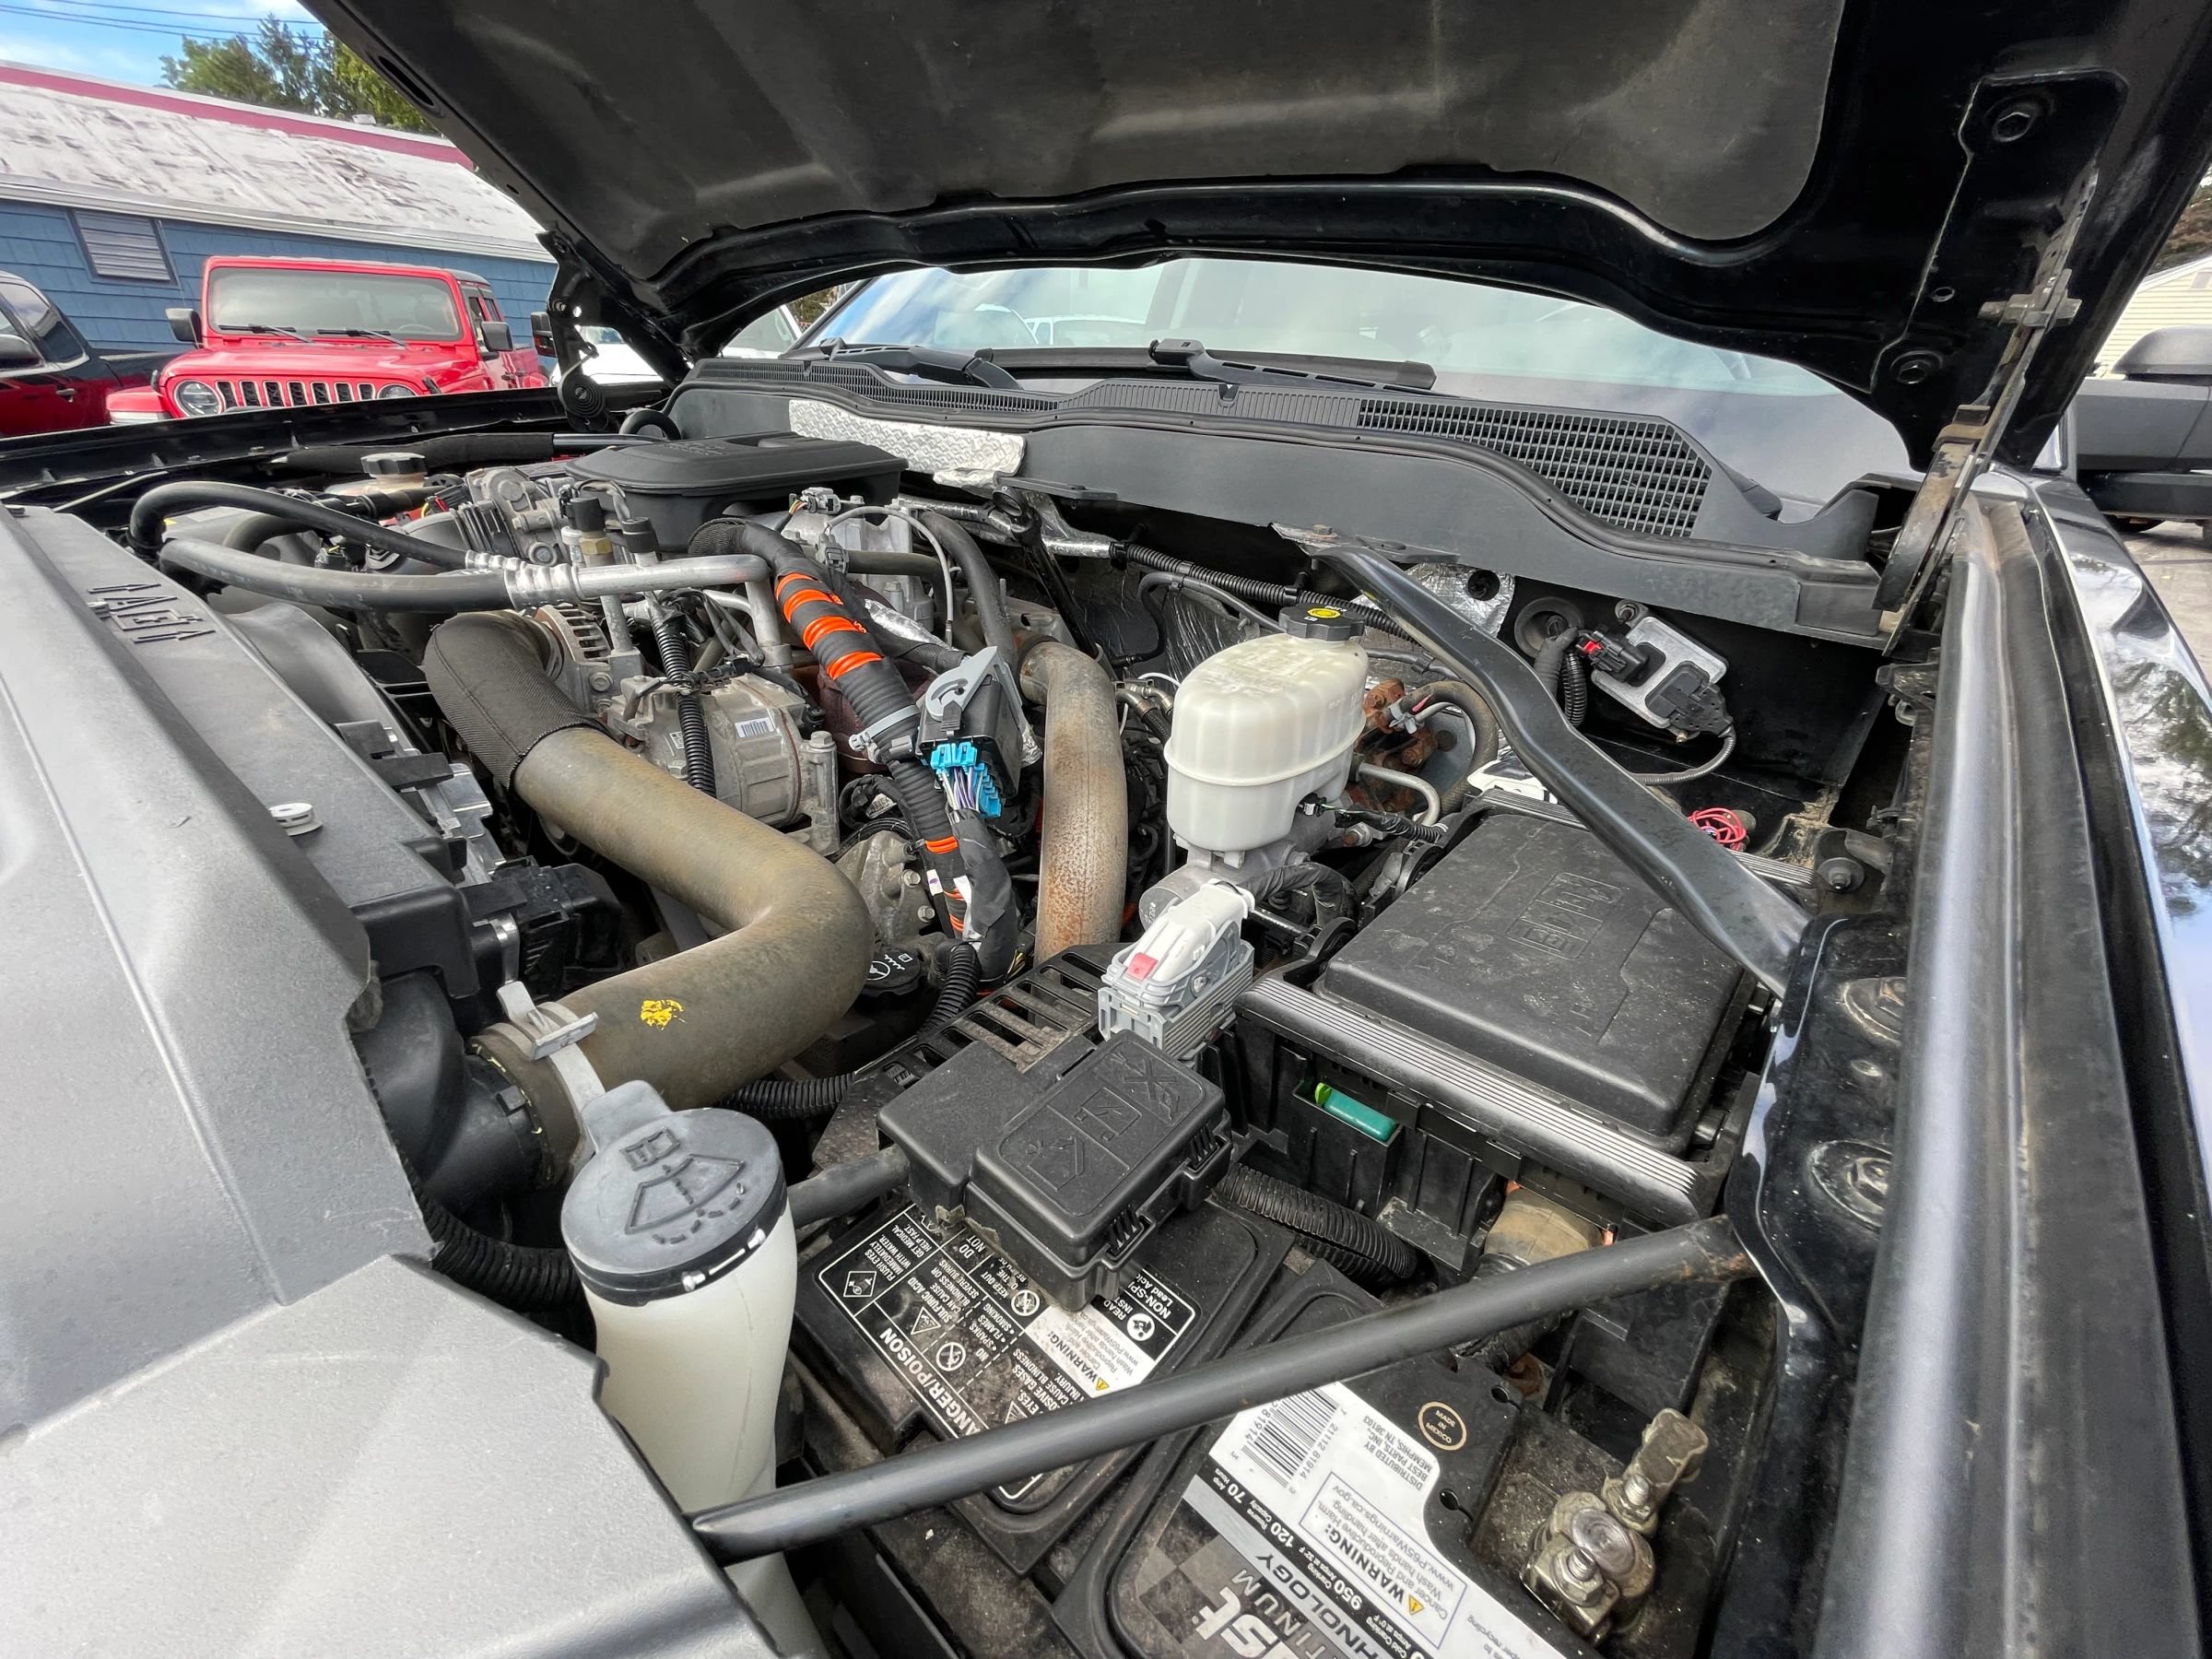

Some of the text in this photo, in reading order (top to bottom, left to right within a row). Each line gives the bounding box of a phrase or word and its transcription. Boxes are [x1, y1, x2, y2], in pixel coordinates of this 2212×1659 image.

[876, 1233, 912, 1269] WITH WATER.
[888, 1223, 925, 1258] GET MEDICAL
[901, 1223, 933, 1252] HELP FAST.
[957, 1242, 975, 1259] DO
[964, 1232, 987, 1253] NOT
[863, 1248, 896, 1281] FLUSH EYES
[868, 1239, 904, 1275] IMMEDIATELY
[929, 1265, 971, 1307] BLINDNESS OR
[954, 1275, 981, 1300] SEVERE
[979, 1269, 1010, 1299] KEEP OUT
[994, 1267, 1012, 1283] THE
[906, 1276, 953, 1324] SULFURIC ACID
[928, 1281, 962, 1314] CAN CAUSE
[1101, 1298, 1127, 1320] READ
[1112, 1295, 1134, 1313] INST
[1125, 1280, 1172, 1319] NON-SPI
[1148, 1286, 1174, 1307] Lead
[976, 1313, 1004, 1340] FLAMES
[982, 1301, 1012, 1331] SMOKING
[968, 1322, 994, 1348] SPARKS
[1076, 1309, 1141, 1367] www.P65Warnings.ca
[973, 1347, 990, 1361] NO
[1044, 1330, 1100, 1382] WARNING:
[1112, 1356, 1135, 1376] Wash
[878, 1326, 982, 1441] ANGER/POISON
[1010, 1363, 1061, 1414] OSIVE GASES
[1011, 1347, 1070, 1405] CAUSE BLINDNESS
[1052, 1371, 1082, 1400] INJURY.
[1013, 1388, 1040, 1415] EYES.
[1424, 1420, 1453, 1445] MEXICO
[1434, 1408, 1457, 1429] MADE
[1436, 1420, 1447, 1430] IN
[1316, 1422, 1338, 1452] 21112
[1361, 1414, 1433, 1473] MEMPHIS, TN 38103
[1299, 1449, 1322, 1479] 81914
[1362, 1440, 1424, 1491] DISTRIBUTED BY
[1379, 1441, 1409, 1466] PARTS,
[1210, 1476, 1227, 1491] Amp
[1406, 1462, 1429, 1482] BEST
[1224, 1481, 1248, 1504] 70
[1243, 1507, 1269, 1530] Reserve
[1247, 1498, 1275, 1523] Capacity
[1266, 1519, 1299, 1549] 120
[1329, 1497, 1444, 1600] Wash hands after handling.
[1331, 1482, 1456, 1591] www.P65Warnings.ca.gov
[1304, 1561, 1335, 1589] Cranking
[1312, 1500, 1450, 1621] Cancer and Reproductive Harm.
[1316, 1561, 1338, 1582] Amps
[1319, 1523, 1409, 1604] WARNING:
[1253, 1546, 1379, 1659] HNOLOGY
[1330, 1577, 1366, 1611] 950
[1194, 1583, 1302, 1659] st
[1230, 1565, 1327, 1659] TINUM
[1362, 1615, 1395, 1645] Cranking
[1390, 1629, 1413, 1650] Amps
[1465, 1614, 1502, 1648] recycling
[1389, 1641, 1408, 1659] Cold
[1480, 1642, 1493, 1654] to
